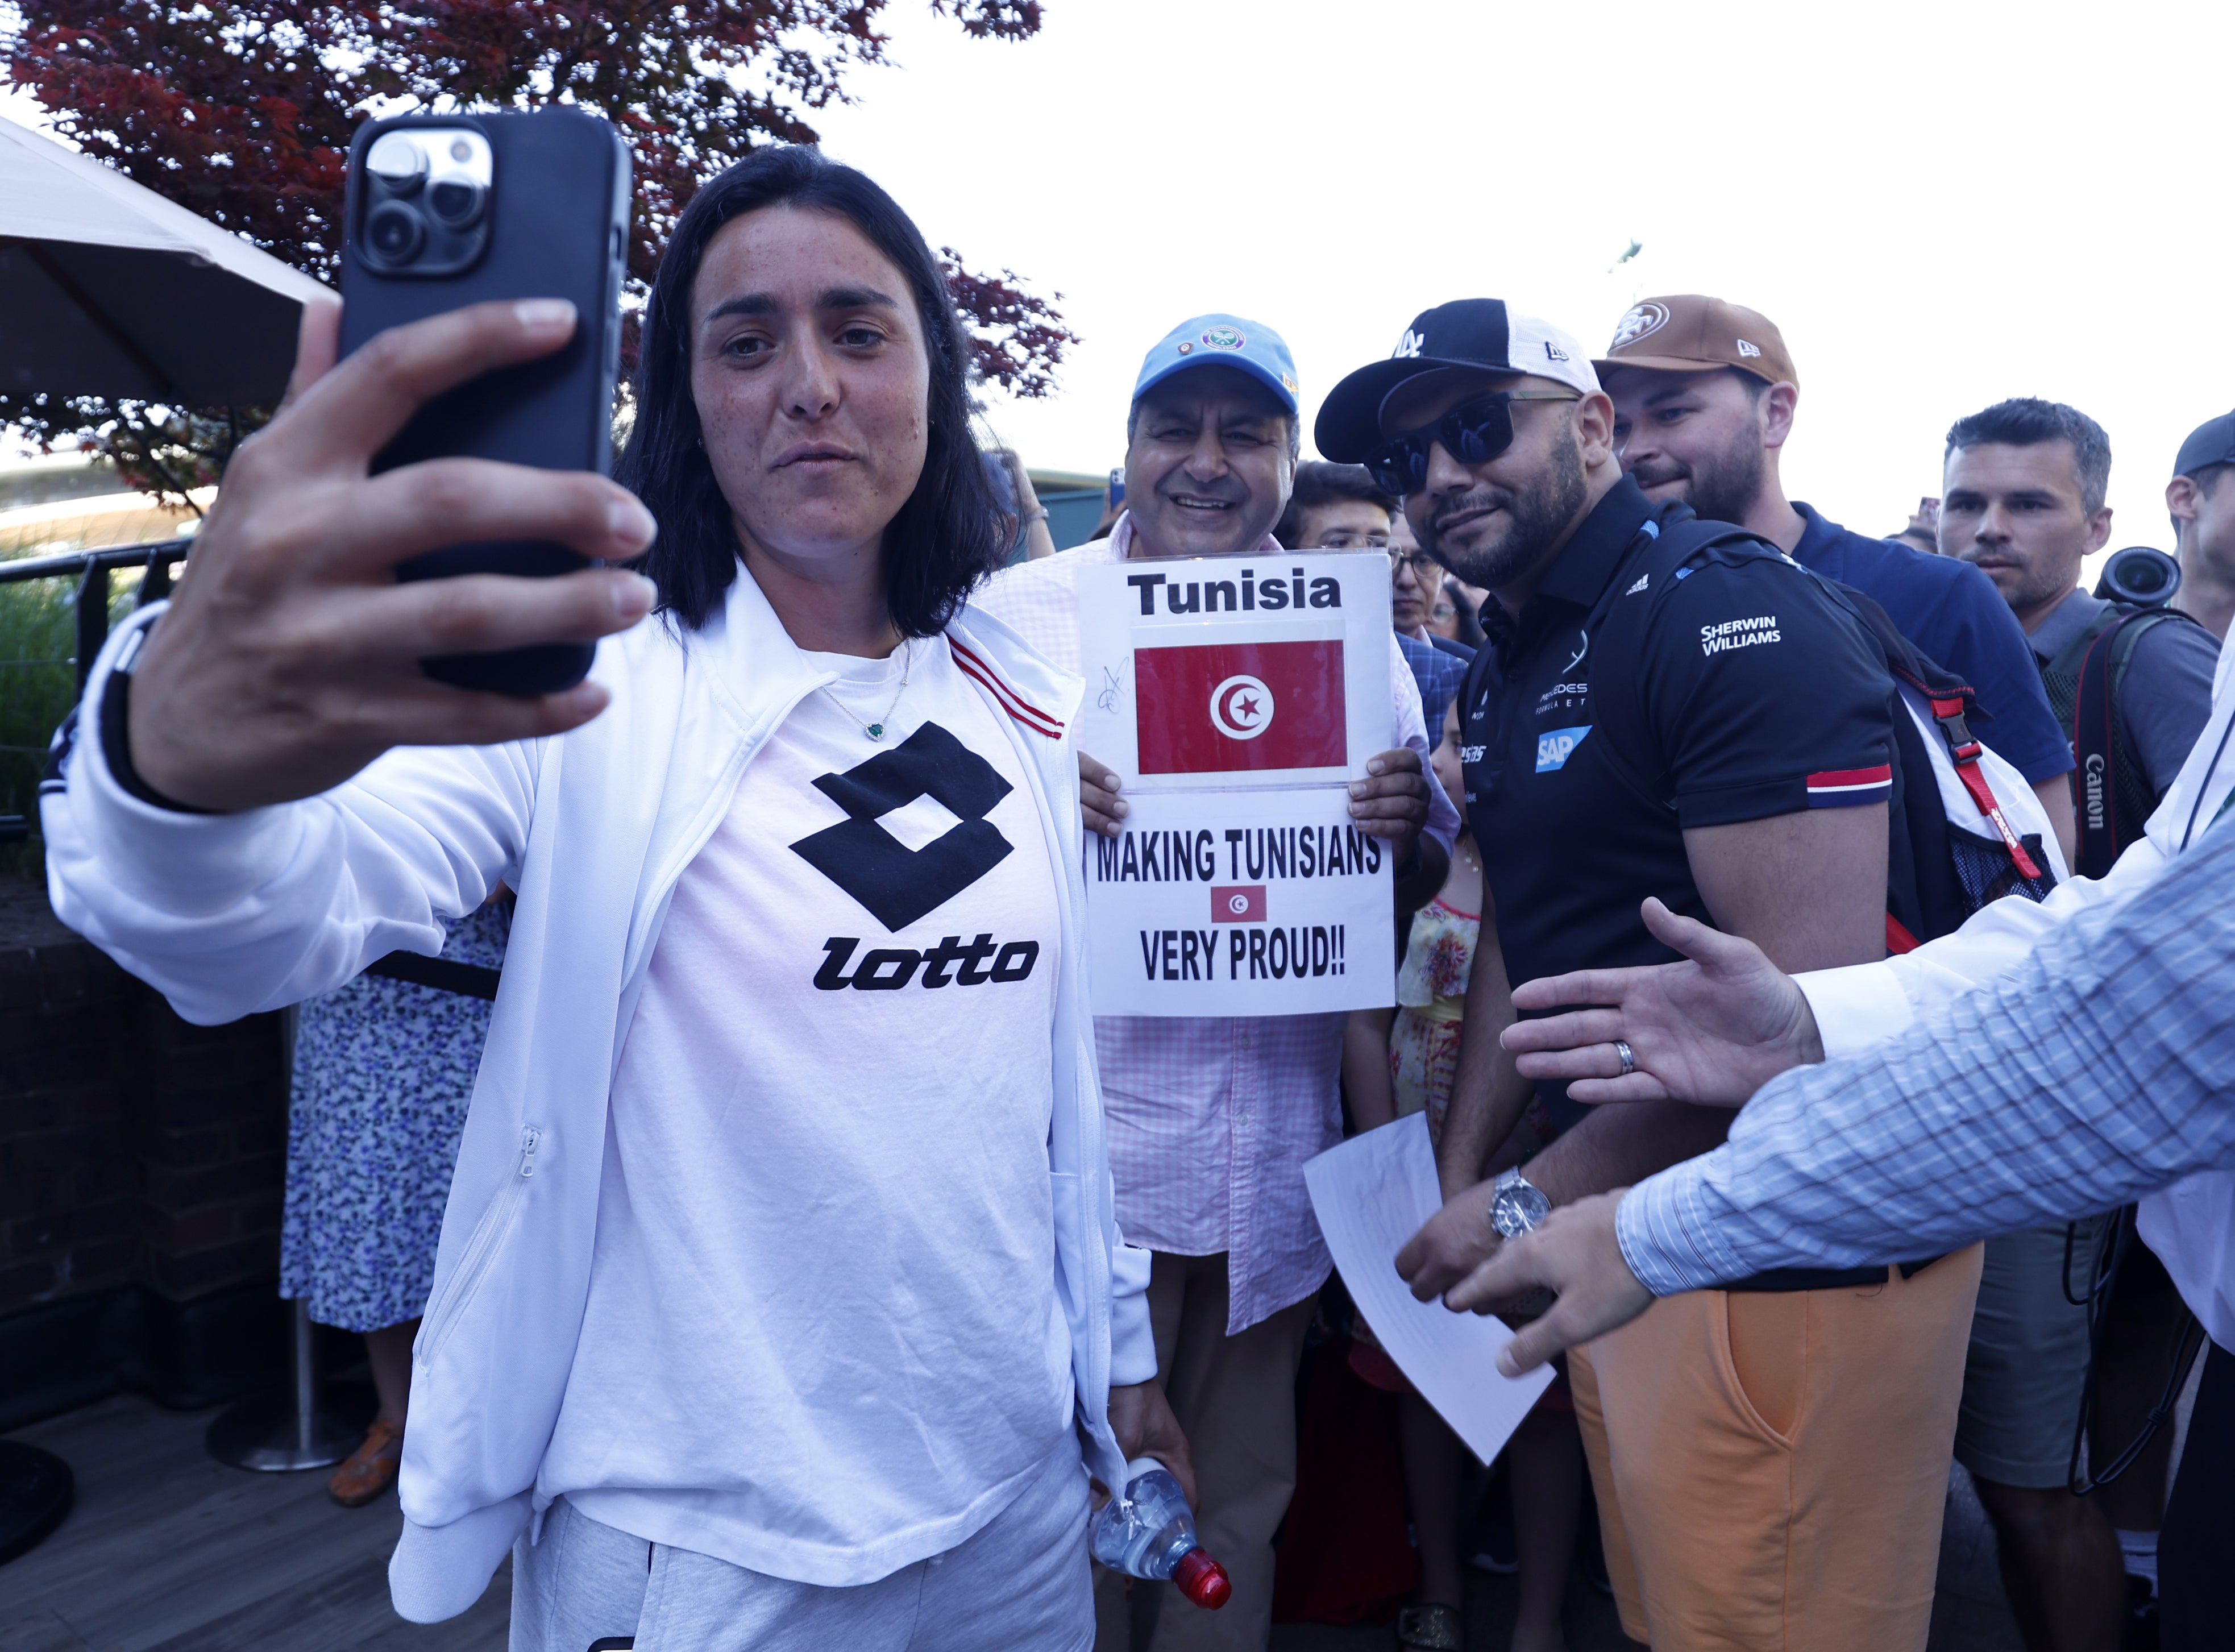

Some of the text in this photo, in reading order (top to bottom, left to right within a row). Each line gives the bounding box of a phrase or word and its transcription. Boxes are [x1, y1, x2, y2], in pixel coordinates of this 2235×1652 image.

[1127, 567, 1342, 615] Tunisia
[1701, 616, 1776, 643] SHERWIN
[1702, 630, 1781, 657] WILLIAMS
[1537, 736, 1574, 766] SAP
[2086, 753, 2105, 830] Canon
[1097, 825, 1381, 882] MAKING TUNISIANS
[813, 933, 1040, 990] lotto
[1140, 924, 1345, 981] VERY PROUD!!
